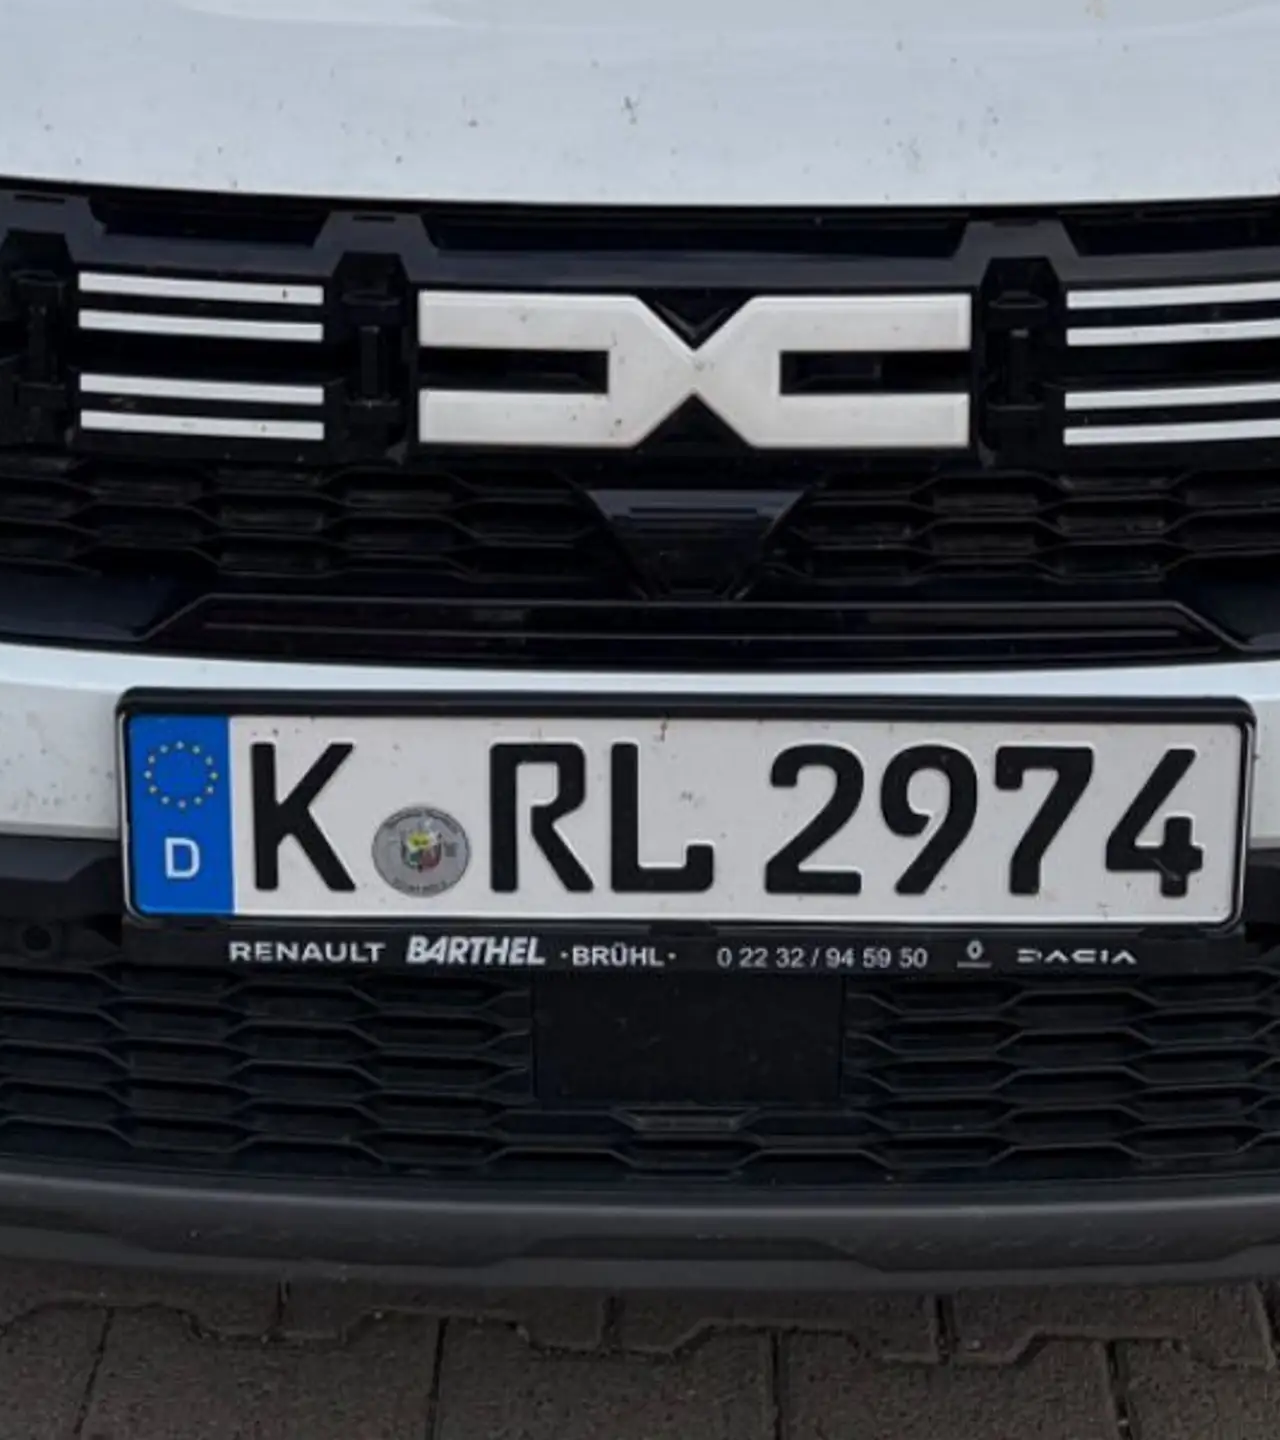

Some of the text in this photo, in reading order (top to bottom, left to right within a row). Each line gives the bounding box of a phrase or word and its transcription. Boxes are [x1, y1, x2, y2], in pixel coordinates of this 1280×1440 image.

[250, 742, 356, 892] K
[489, 742, 715, 894] RL
[764, 744, 1204, 899] 2974
[165, 837, 200, 878] D
[229, 941, 385, 962] RENAULT
[406, 935, 547, 966] BARTHEL
[717, 947, 733, 968] 0
[739, 947, 768, 968] 22
[775, 947, 805, 968] 32
[826, 947, 854, 968] 94
[862, 947, 892, 968] 59
[899, 947, 928, 968] 50
